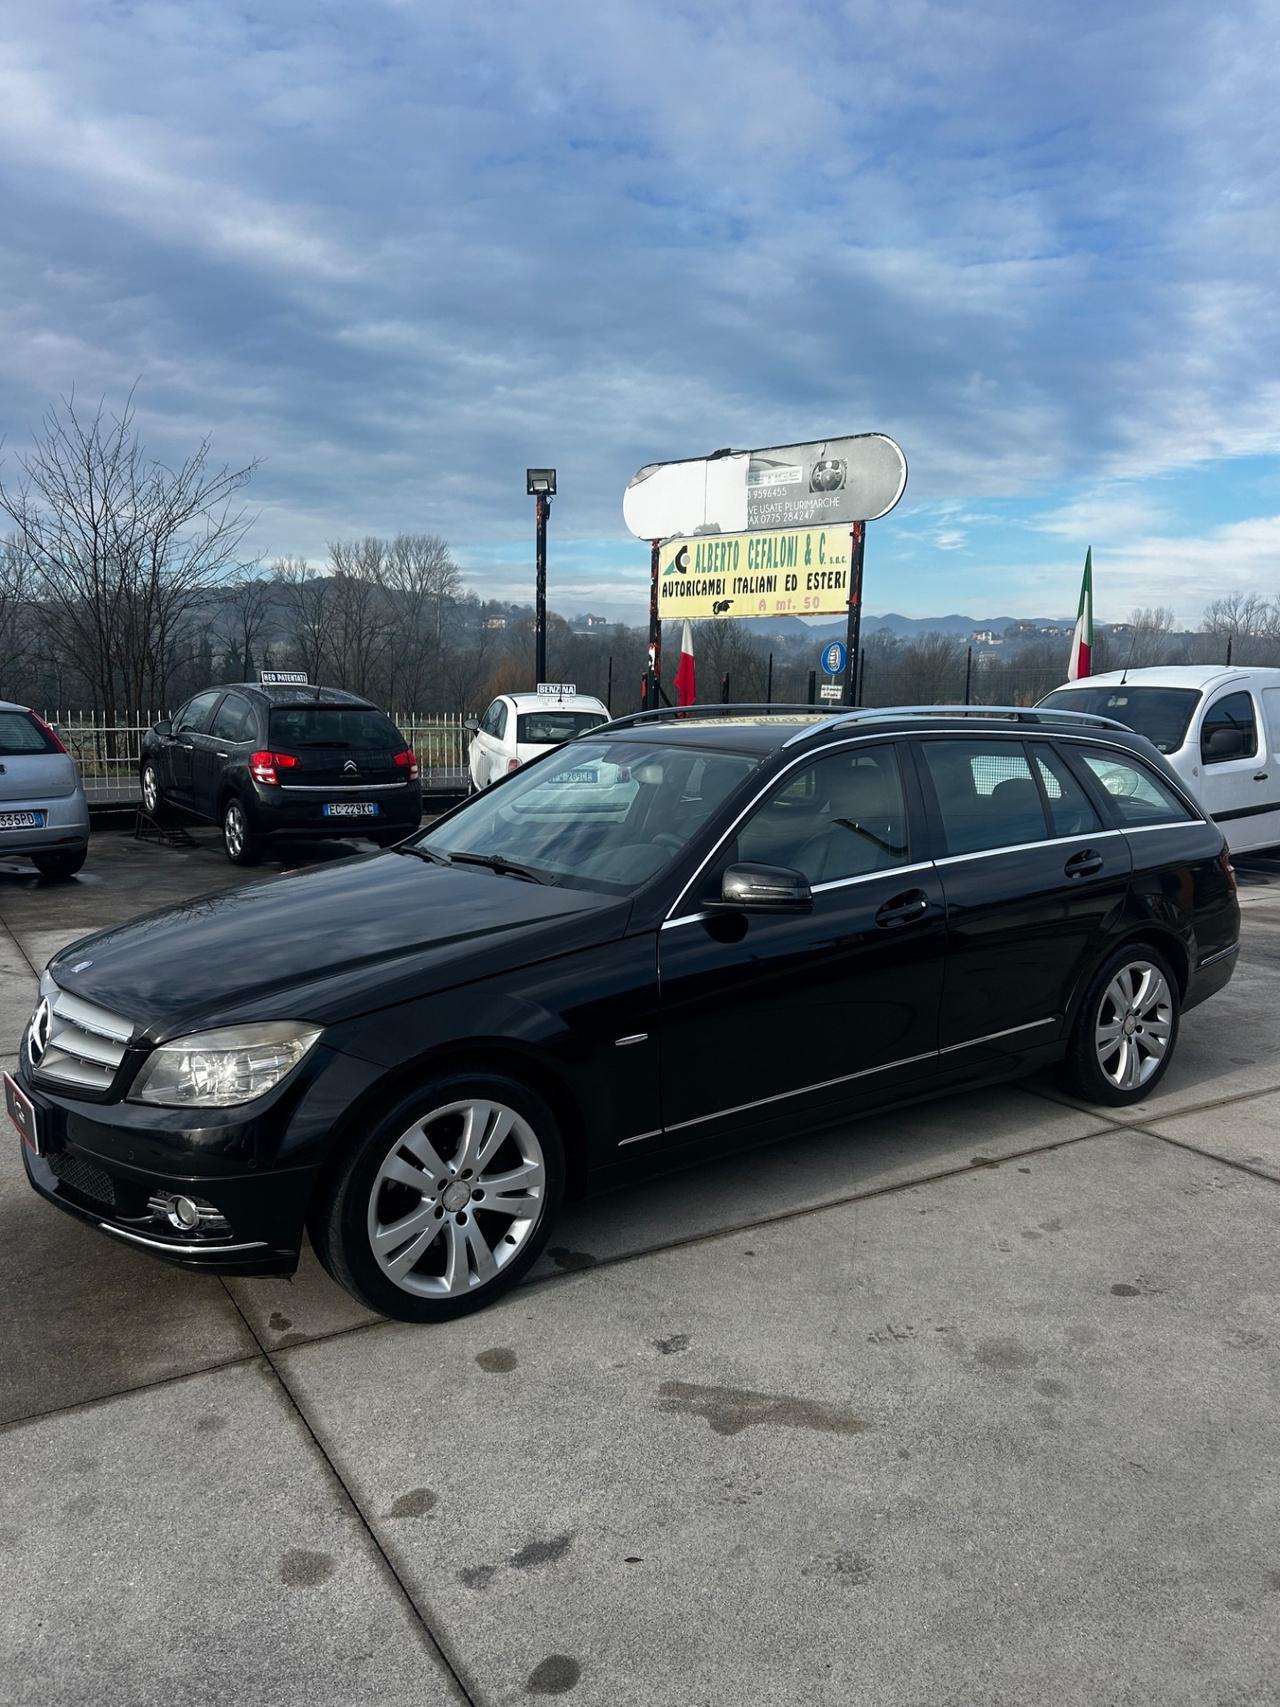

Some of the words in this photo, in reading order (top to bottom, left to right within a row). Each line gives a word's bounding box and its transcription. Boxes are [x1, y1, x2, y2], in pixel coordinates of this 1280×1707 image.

[748, 505, 758, 515] VE
[760, 502, 782, 514] USATE
[785, 496, 840, 511] PLURIMARCHE
[748, 515, 759, 525] AX
[761, 512, 781, 524] 0775
[783, 510, 815, 522] 284247
[695, 540, 740, 574] ALBERTO
[748, 535, 798, 570] CEFALONI
[804, 533, 812, 566] &
[662, 578, 726, 598] AUTORICAMBI
[733, 574, 777, 595] ITALIANI
[785, 573, 798, 592] ED
[806, 570, 846, 591] ESTERI
[758, 598, 767, 611] A
[804, 595, 820, 610] 50
[540, 685, 574, 694] BENZNA
